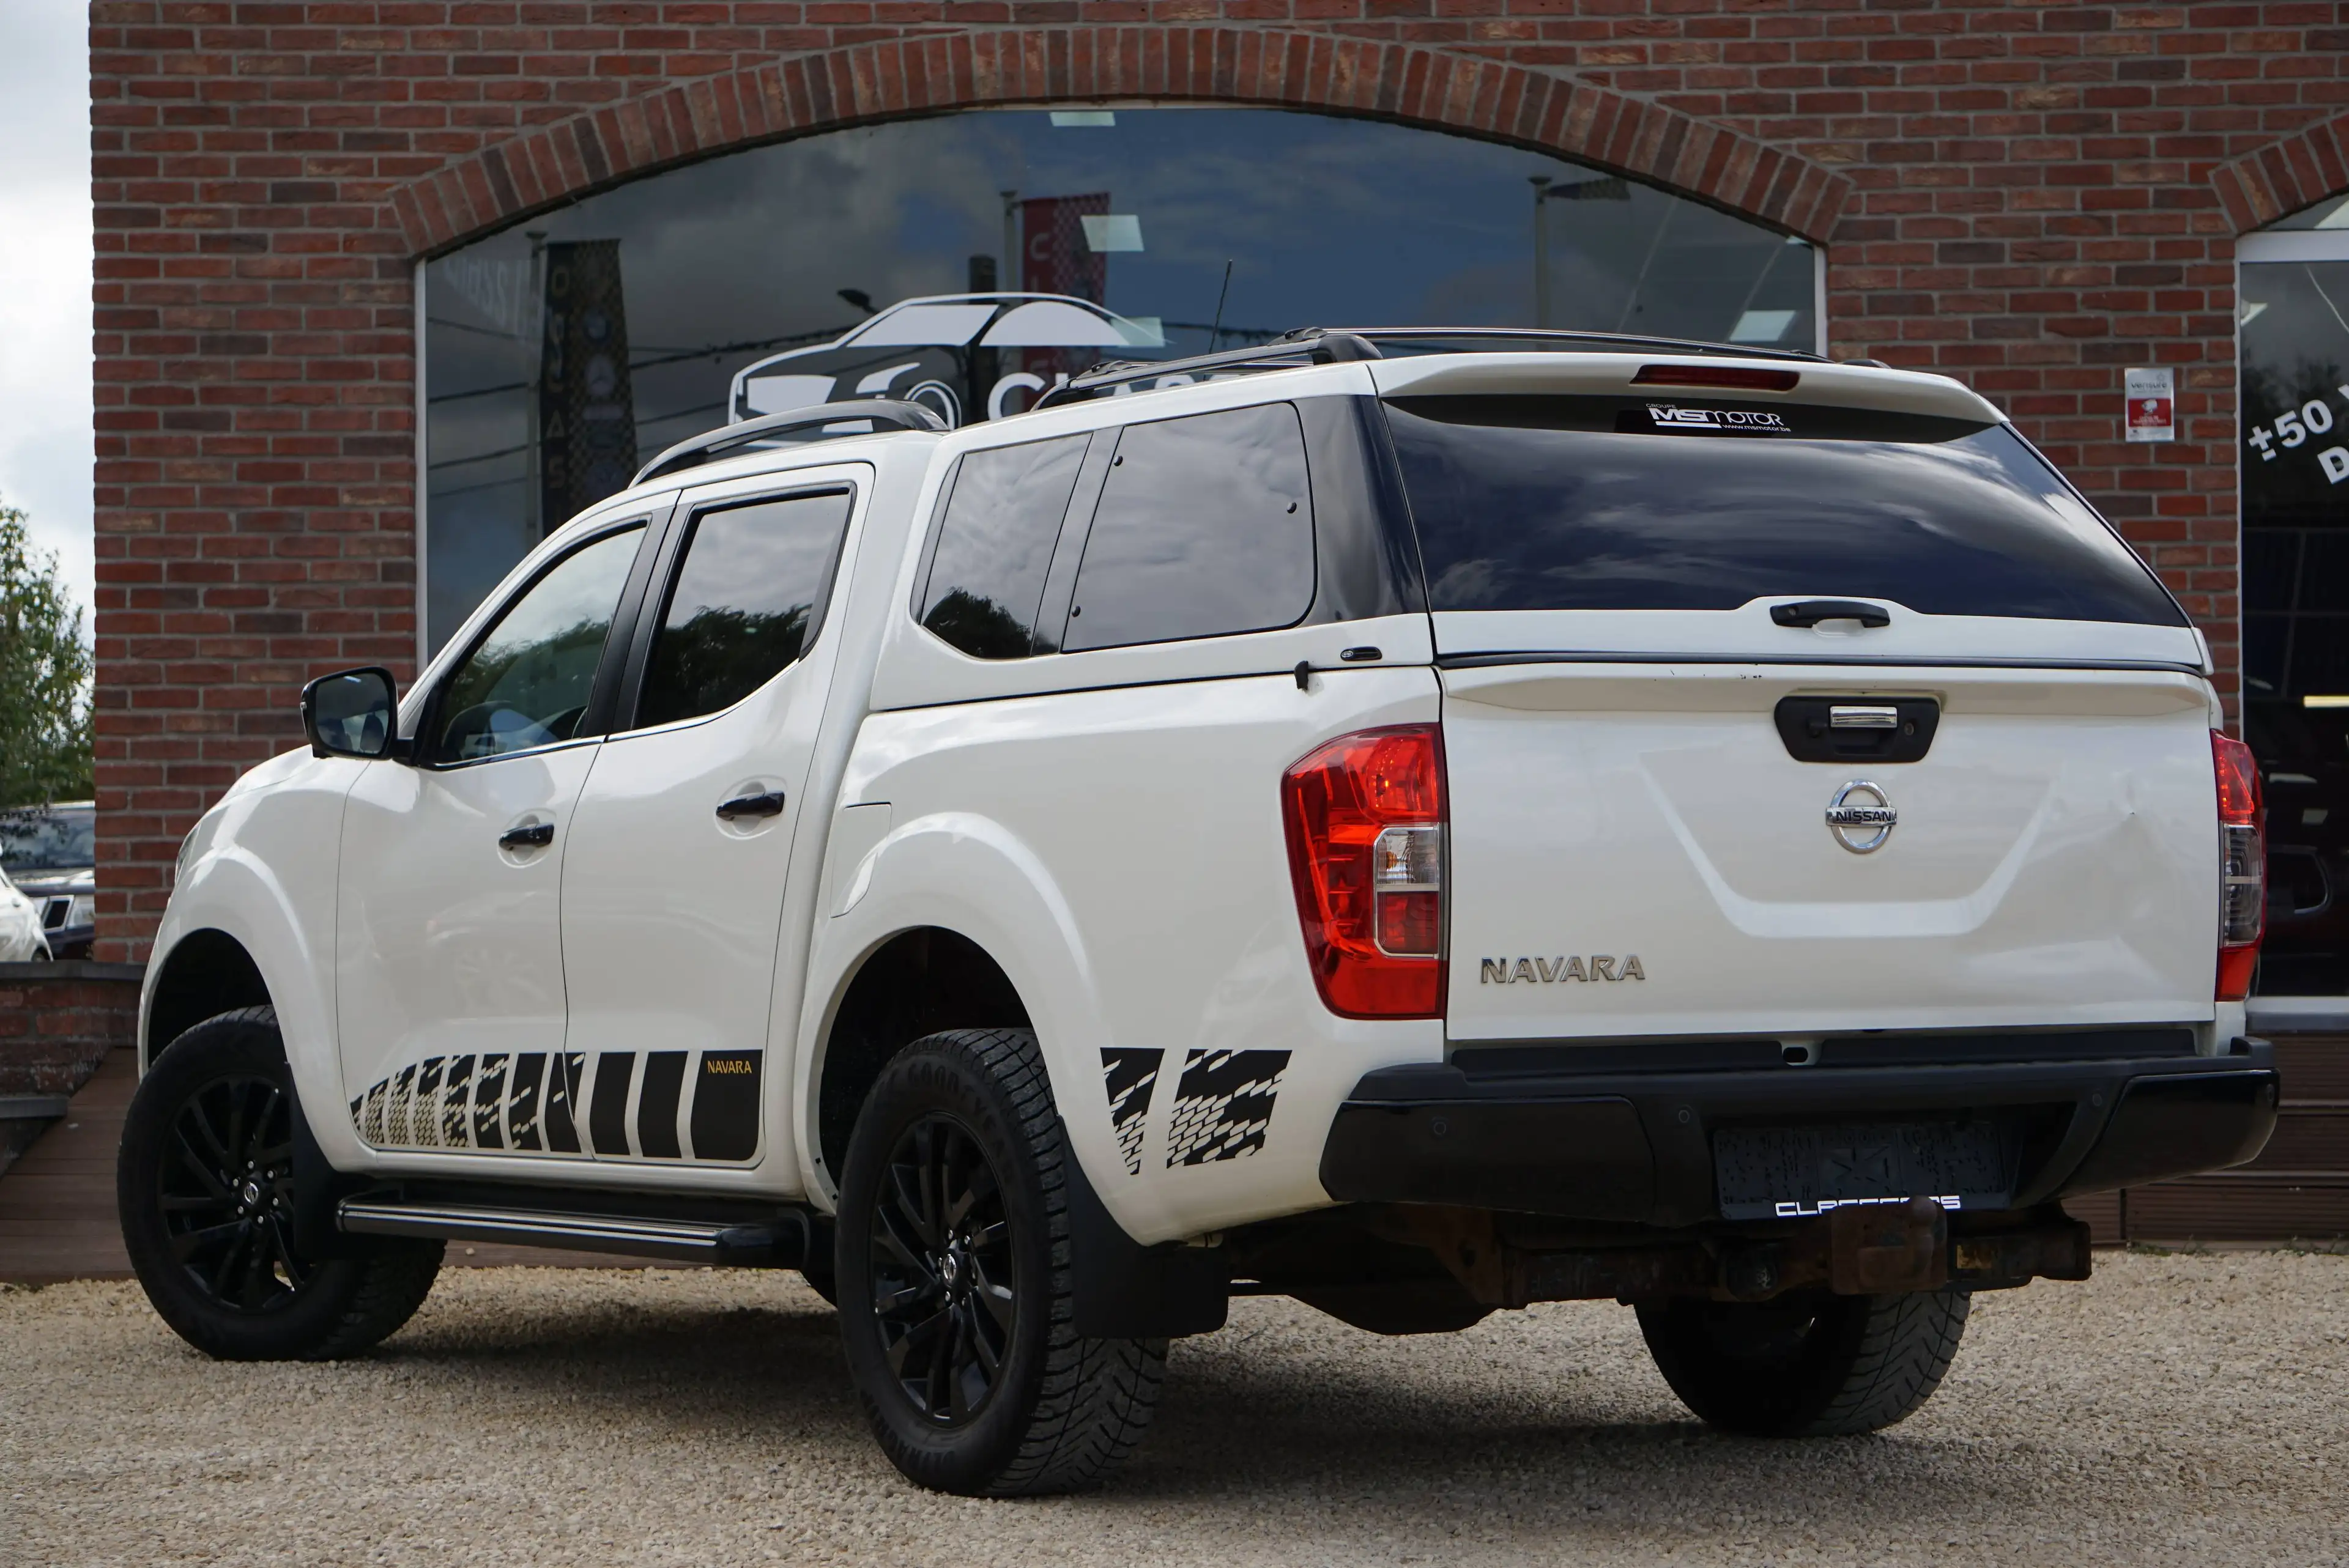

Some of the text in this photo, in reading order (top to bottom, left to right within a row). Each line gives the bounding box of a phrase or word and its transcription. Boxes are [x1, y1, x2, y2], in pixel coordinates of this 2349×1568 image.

[1722, 423, 1791, 432] www.msmotor.be
[1836, 810, 1892, 822] NISSAN
[1480, 954, 1646, 984] NAVARA
[707, 1060, 752, 1074] NAVARA
